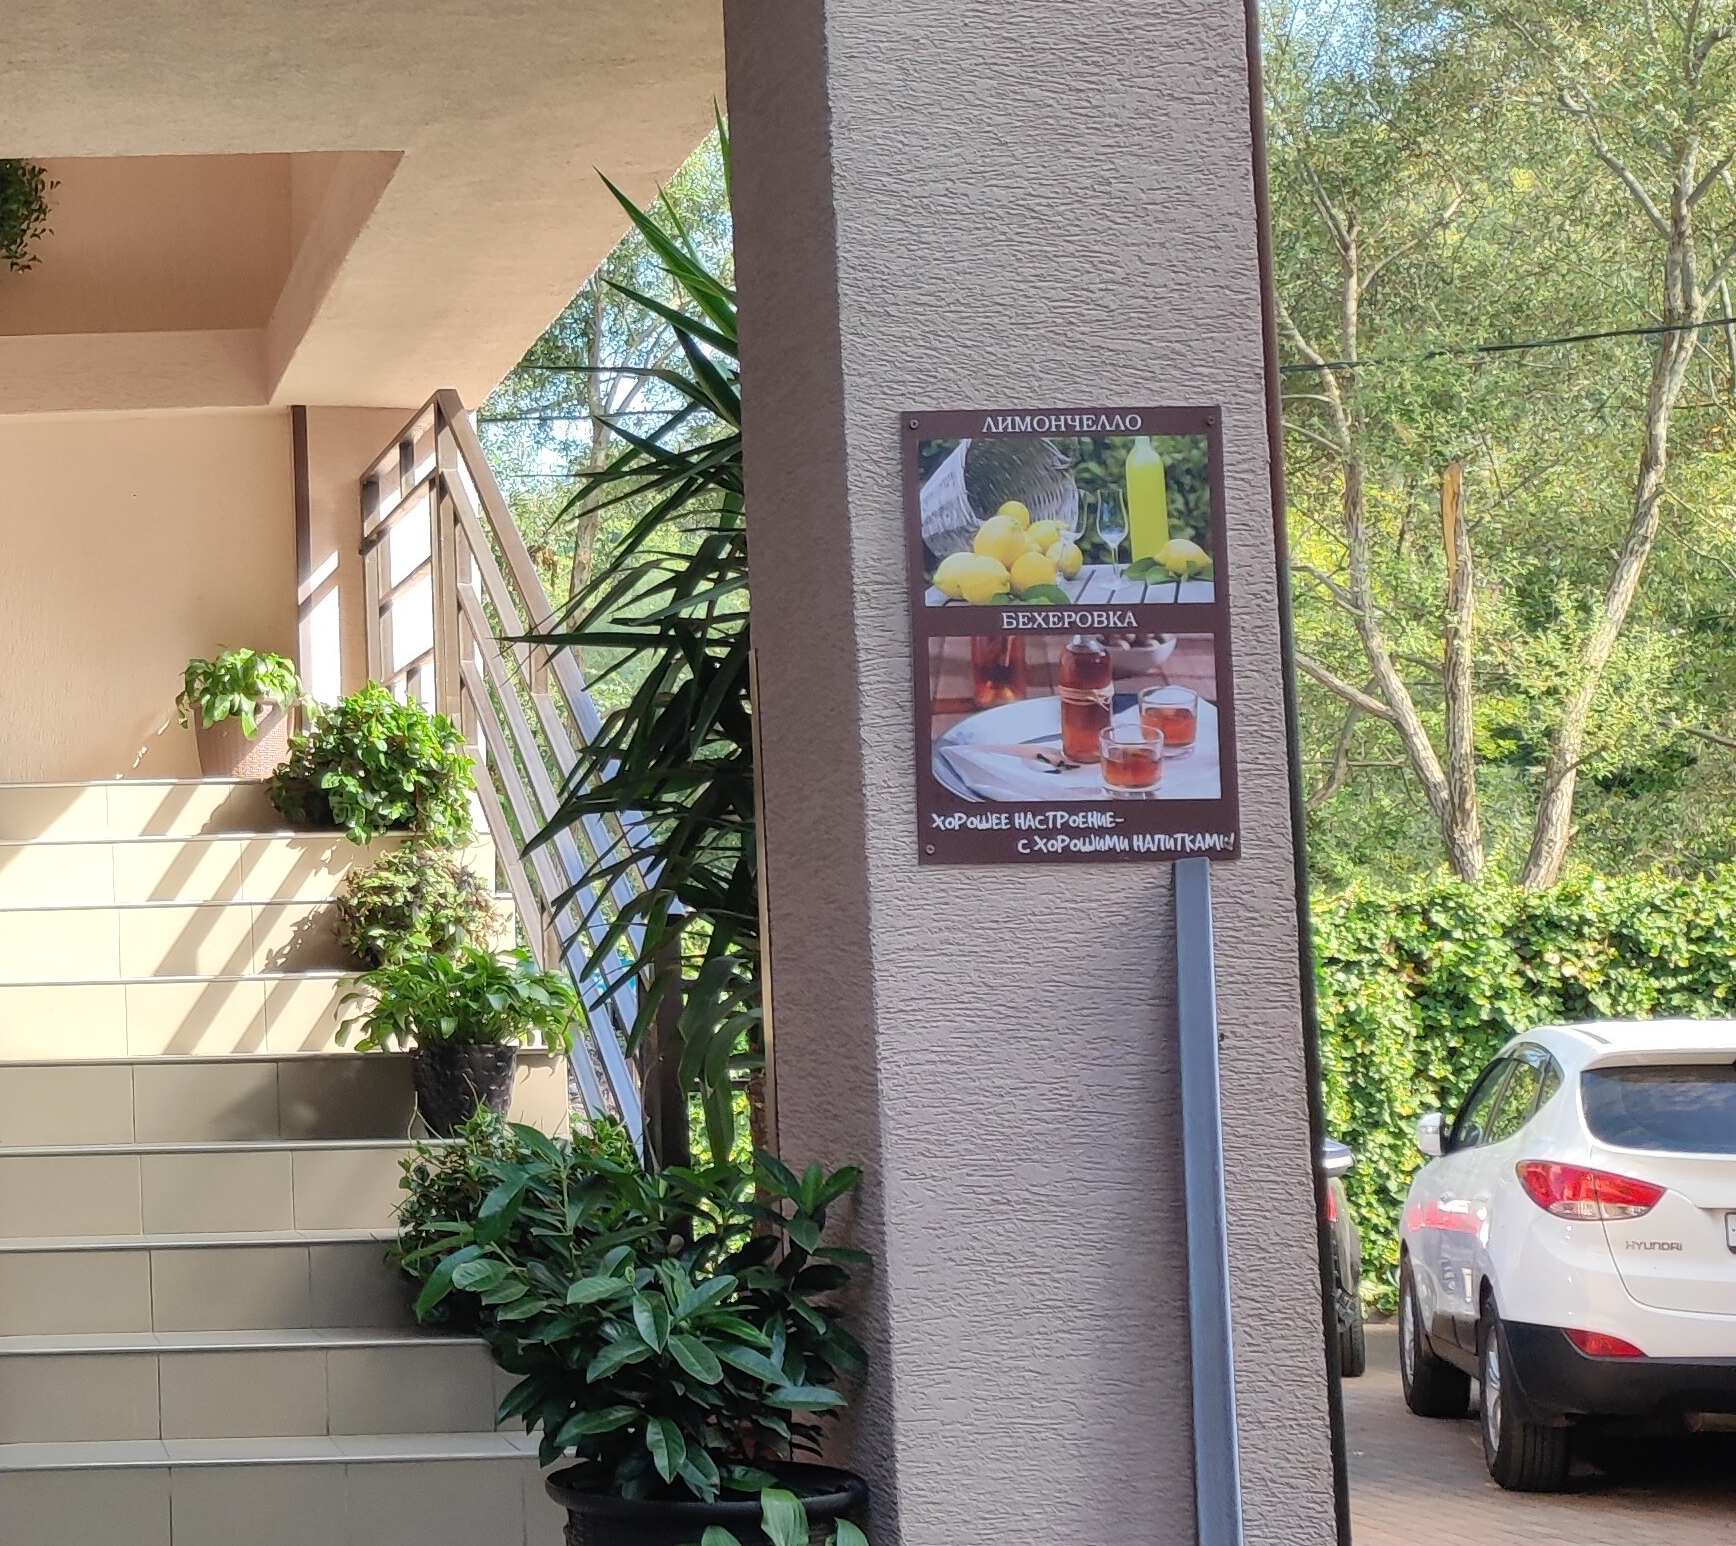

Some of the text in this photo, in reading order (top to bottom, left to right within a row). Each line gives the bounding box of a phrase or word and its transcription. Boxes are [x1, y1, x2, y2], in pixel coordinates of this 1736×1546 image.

[981, 414, 1142, 433] ЛИМОНЧЕЛЛО
[1001, 610, 1138, 629] БЕХЕРОВКА
[931, 811, 1011, 831] ХОРОШЕЕ
[1017, 837, 1031, 854] С
[1033, 833, 1130, 854] ХОРОШИМИ
[1625, 1240, 1683, 1251] HYUNDAI
